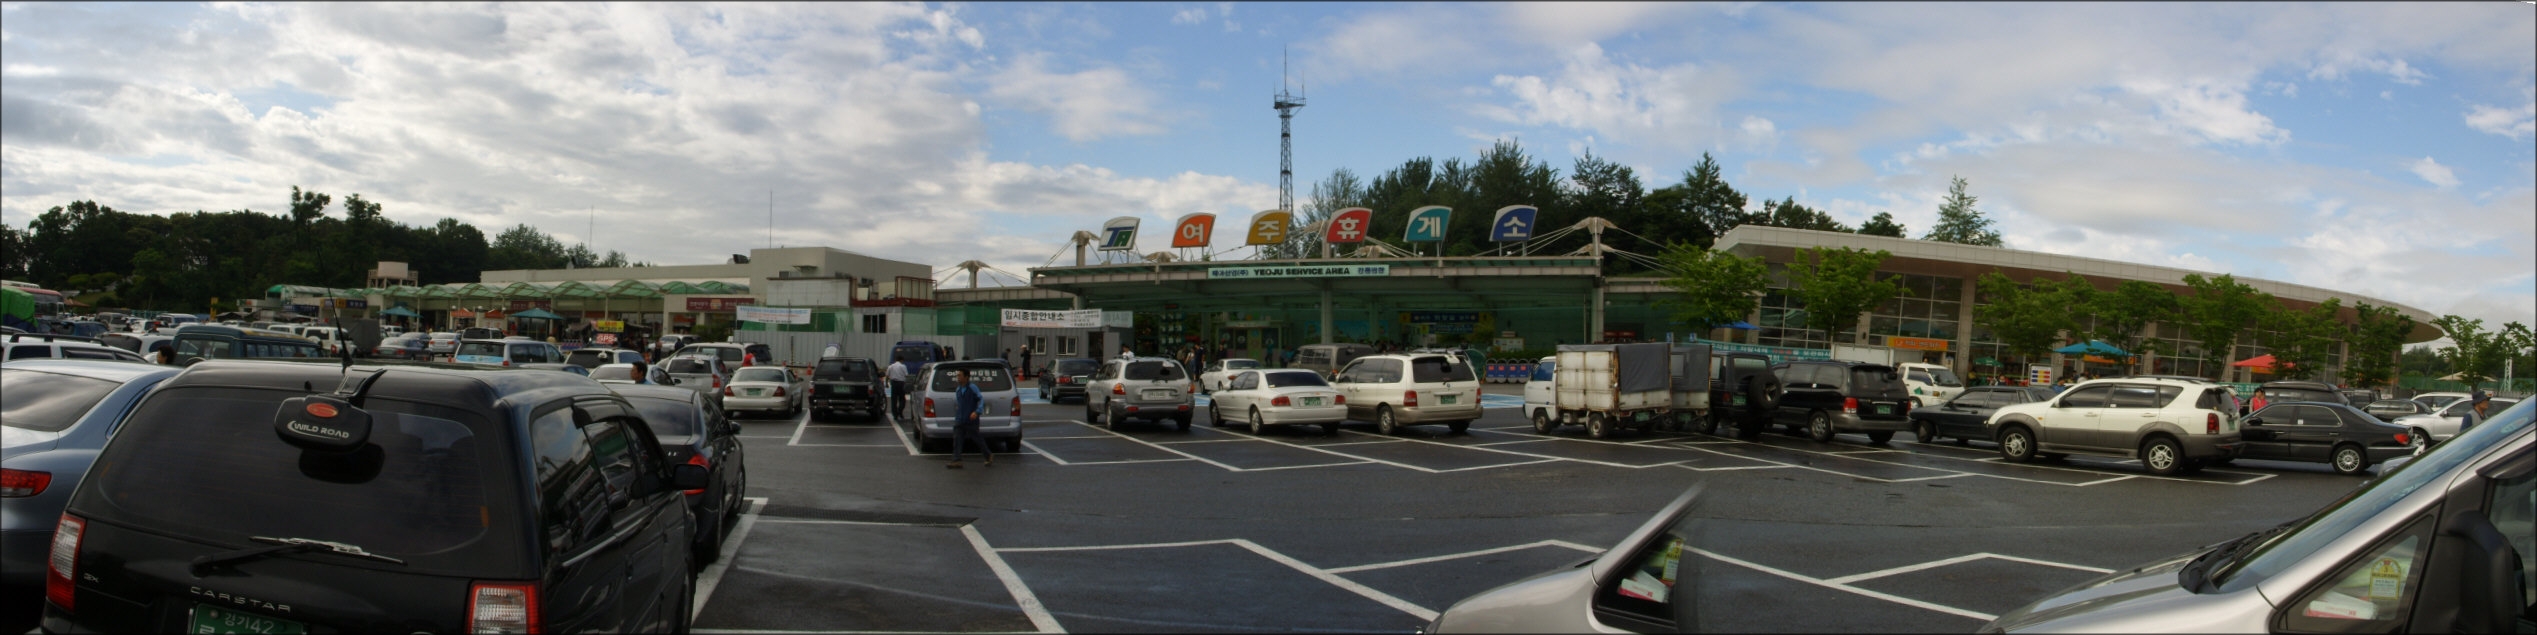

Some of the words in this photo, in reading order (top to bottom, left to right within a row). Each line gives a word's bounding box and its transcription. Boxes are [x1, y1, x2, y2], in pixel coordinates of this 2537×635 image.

[1182, 222, 1204, 243] 여
[1257, 220, 1281, 241] 주
[1336, 216, 1361, 240] 휴
[1416, 216, 1441, 238] 게
[1502, 216, 1528, 238] 소
[1254, 268, 1284, 277] YEOJU
[1286, 267, 1324, 276] SERVICE
[1325, 266, 1351, 275] AREA
[1005, 310, 1065, 321] 임시종합안내소
[294, 422, 319, 433] WILD
[320, 427, 350, 439] ROAD
[190, 586, 291, 613] CARSTAR
